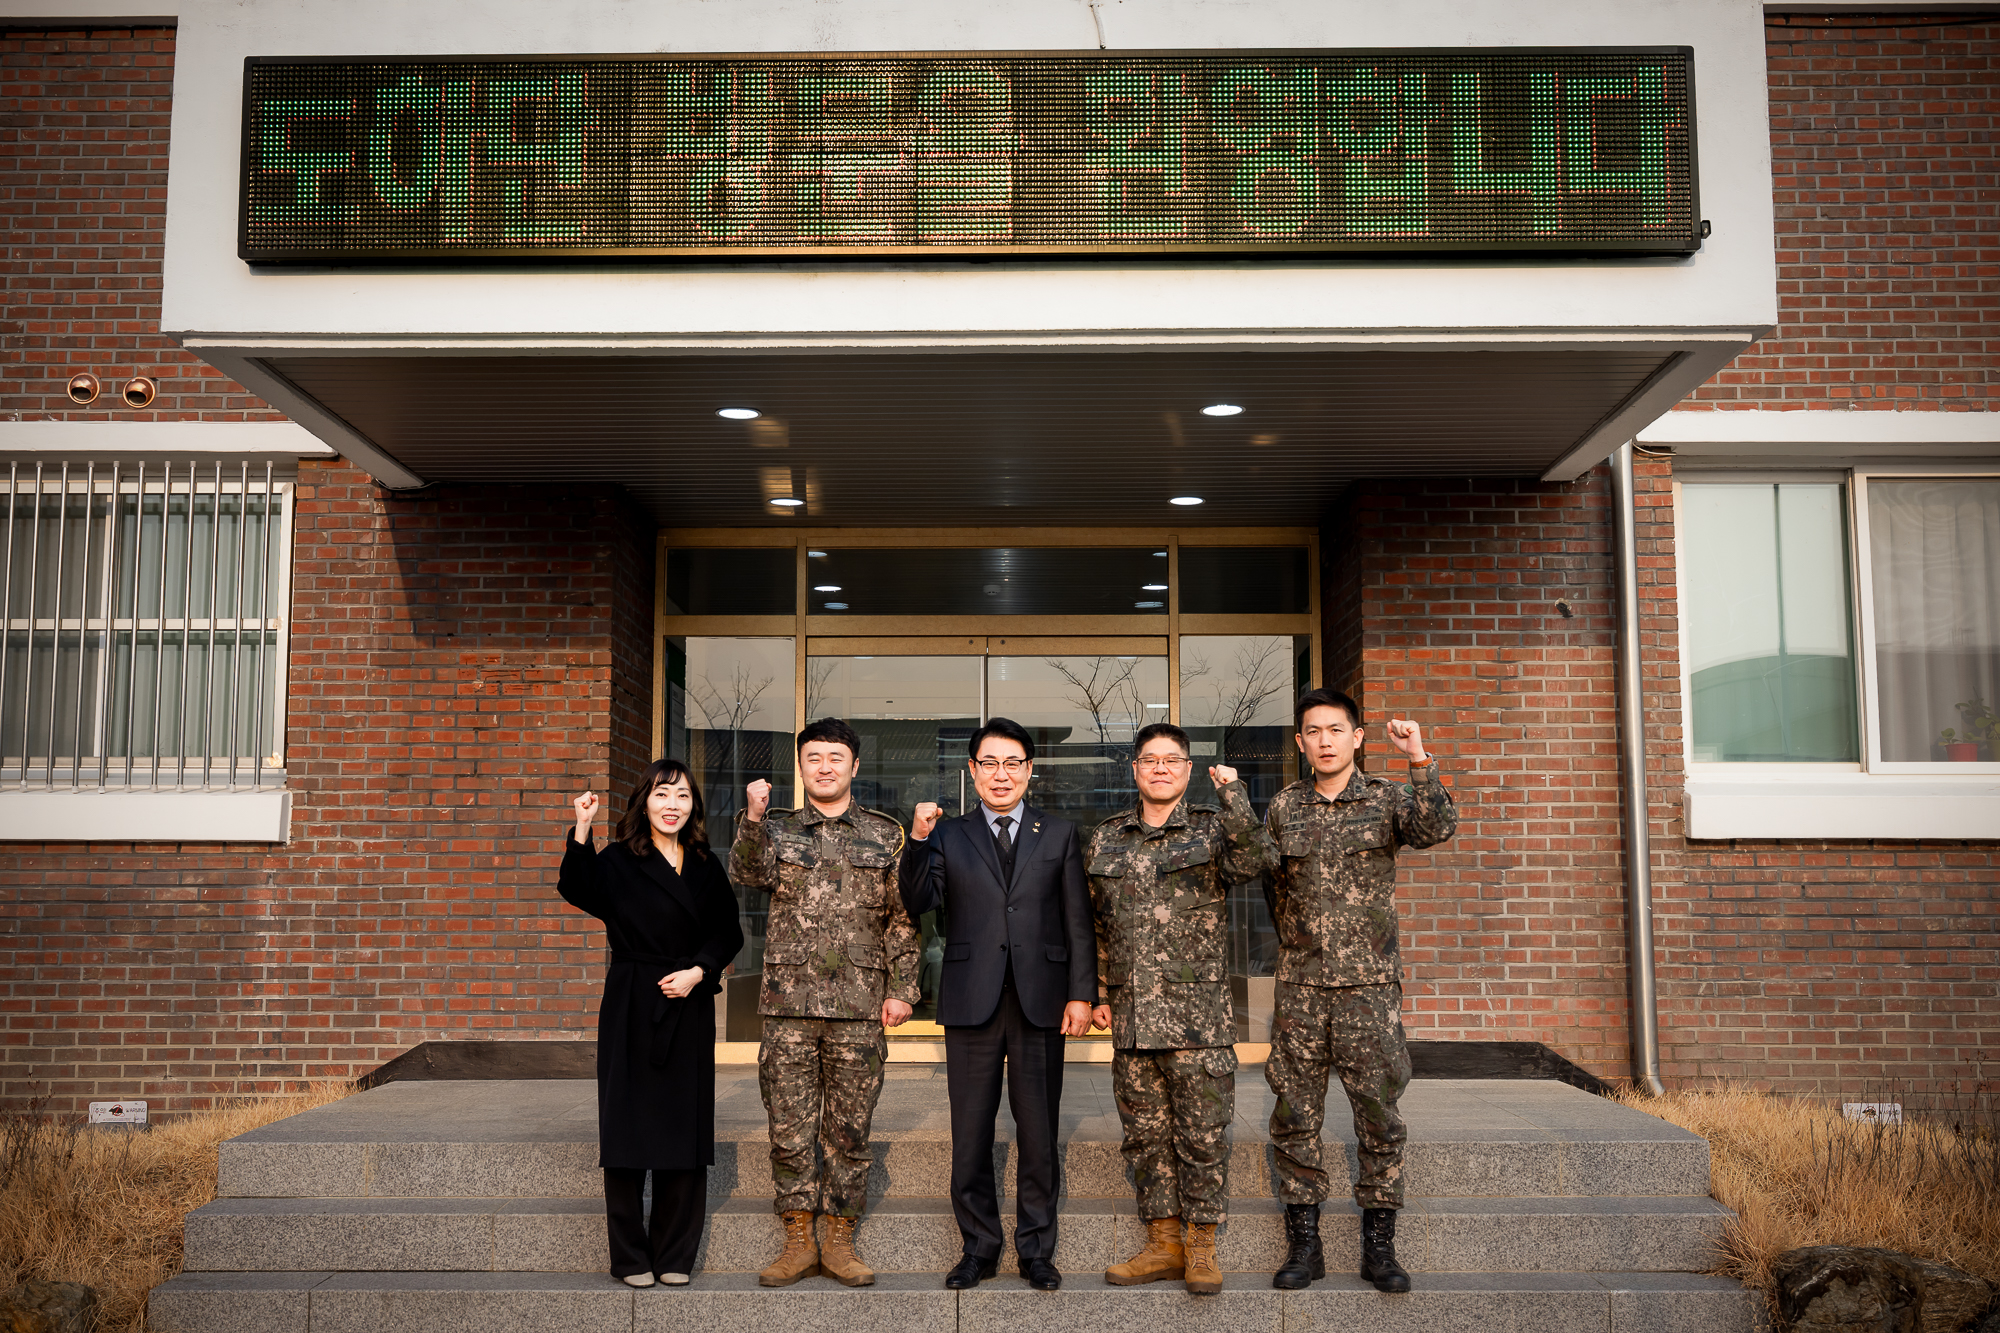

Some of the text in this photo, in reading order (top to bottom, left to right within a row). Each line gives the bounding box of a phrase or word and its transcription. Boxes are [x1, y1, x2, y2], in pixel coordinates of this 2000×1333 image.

[254, 64, 1682, 242] 도하단 방문을 환영합니다
